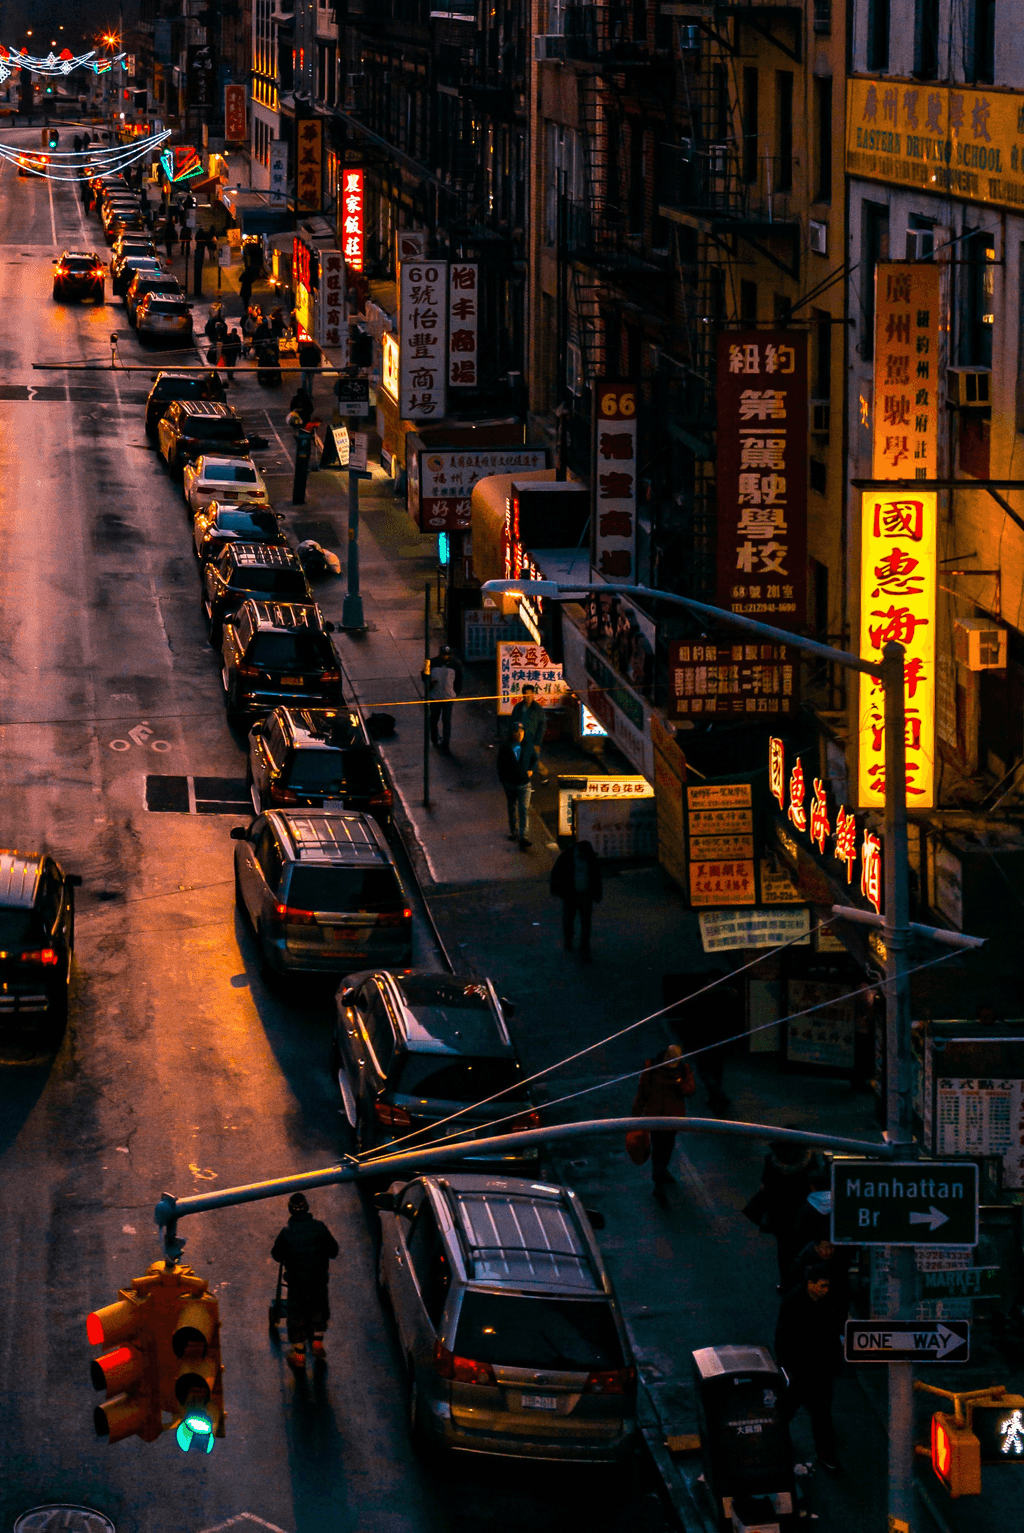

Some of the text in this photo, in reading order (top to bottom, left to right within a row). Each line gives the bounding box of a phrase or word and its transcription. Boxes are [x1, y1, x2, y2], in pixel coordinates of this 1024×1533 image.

[862, 85, 991, 142] 廣州駕駛學校
[856, 127, 901, 154] EASTERN
[906, 134, 951, 164] DRIVING
[957, 141, 1003, 173] SCHOOL
[343, 173, 363, 257] 農家飯莊
[326, 256, 342, 345] 興旺旺商場
[451, 266, 476, 384] 怡丰商場
[729, 343, 796, 375] 紐約
[883, 272, 913, 479] 廣州駕駛學
[600, 393, 636, 416] 66
[433, 470, 484, 485] 福州大
[736, 389, 789, 577] 第一駕駛學校
[587, 782, 645, 793] 州百合花店
[846, 1177, 964, 1199] Manhattan
[858, 1207, 881, 1227] Br
[925, 1271, 981, 1289] MARKET
[857, 1333, 952, 1349] ONE WAY
